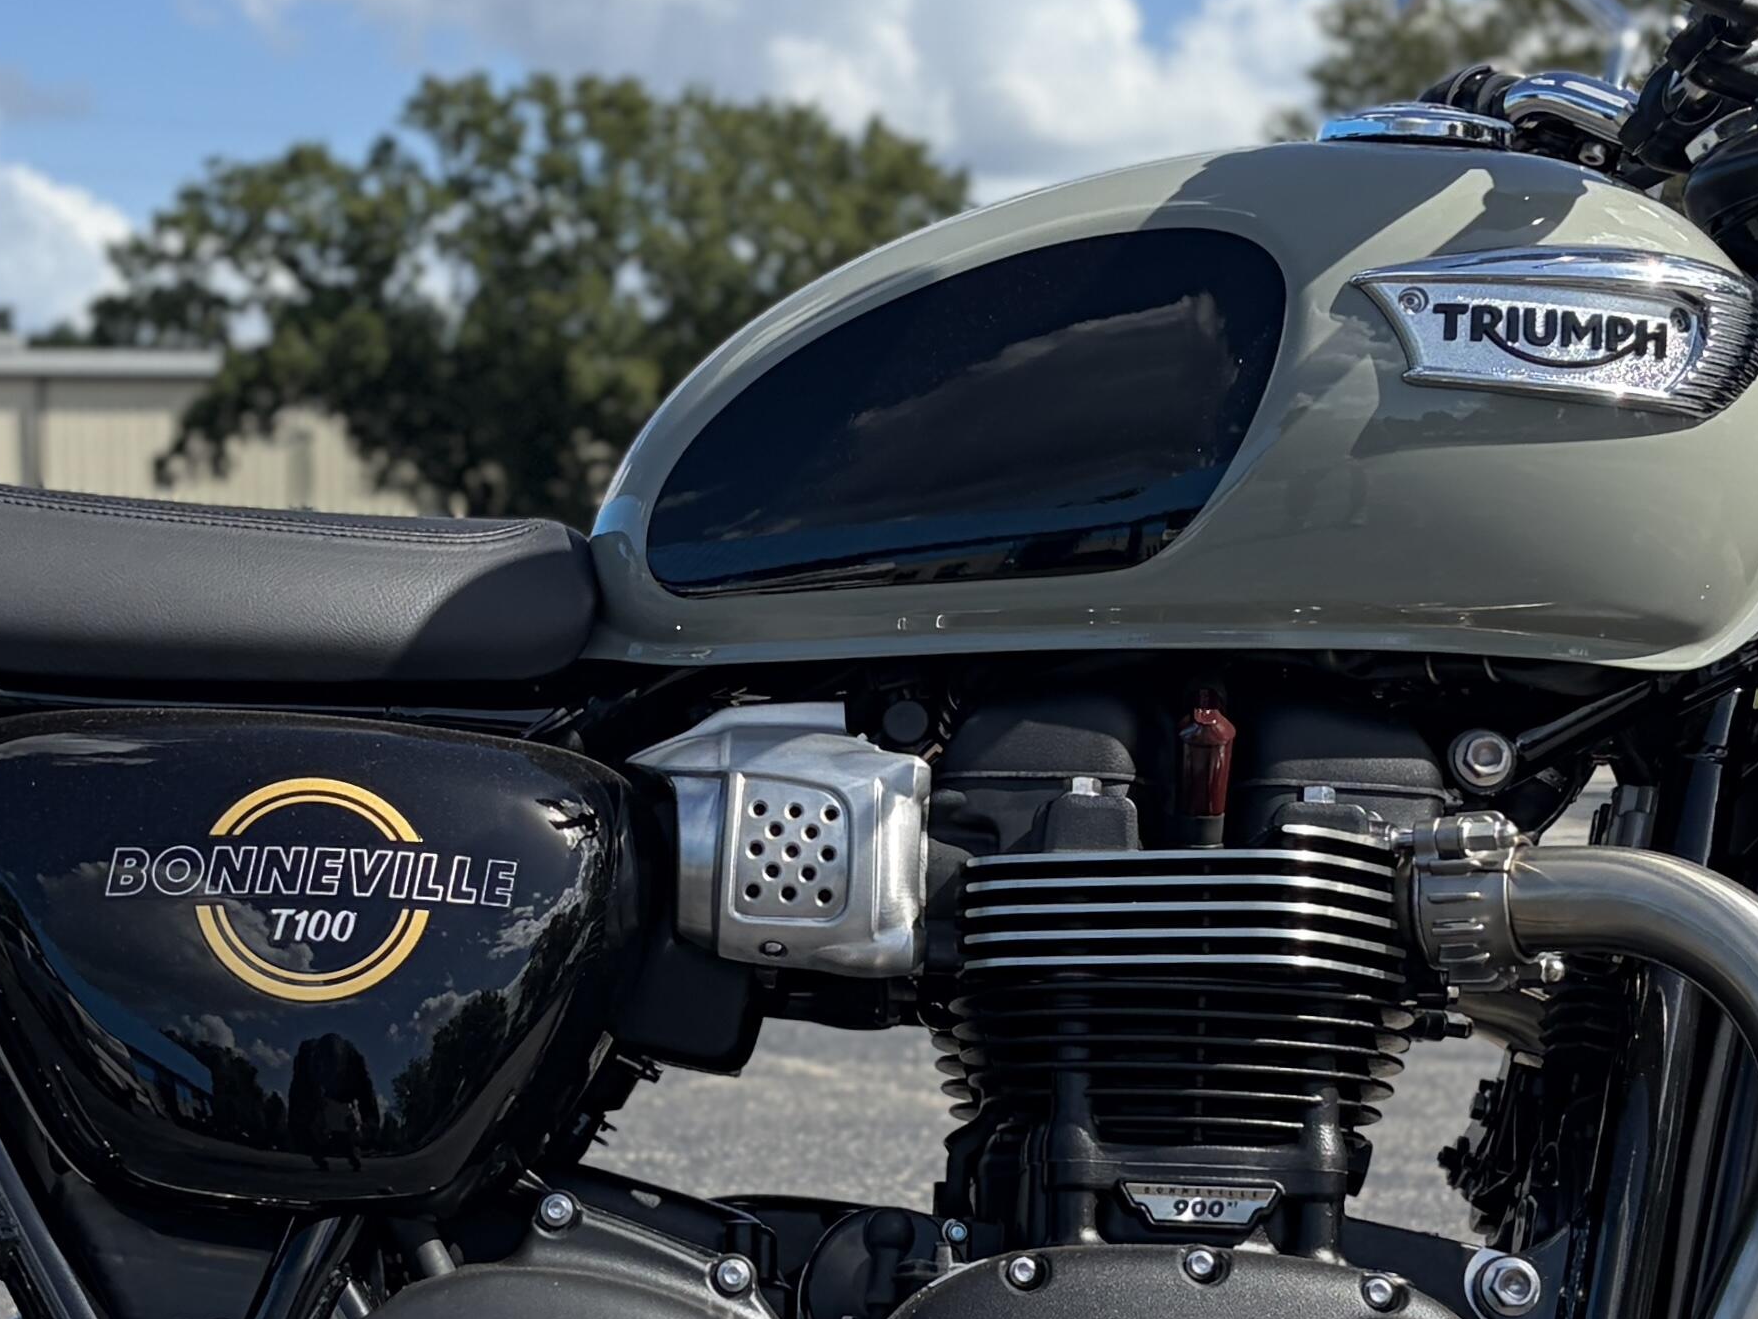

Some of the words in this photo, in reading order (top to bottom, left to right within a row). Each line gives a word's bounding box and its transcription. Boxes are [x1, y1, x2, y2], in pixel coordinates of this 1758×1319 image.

[1432, 302, 1668, 368] TRIUMPH
[104, 845, 519, 908] BONNEVILLE
[271, 908, 358, 943] T100
[1173, 1199, 1224, 1218] 900
